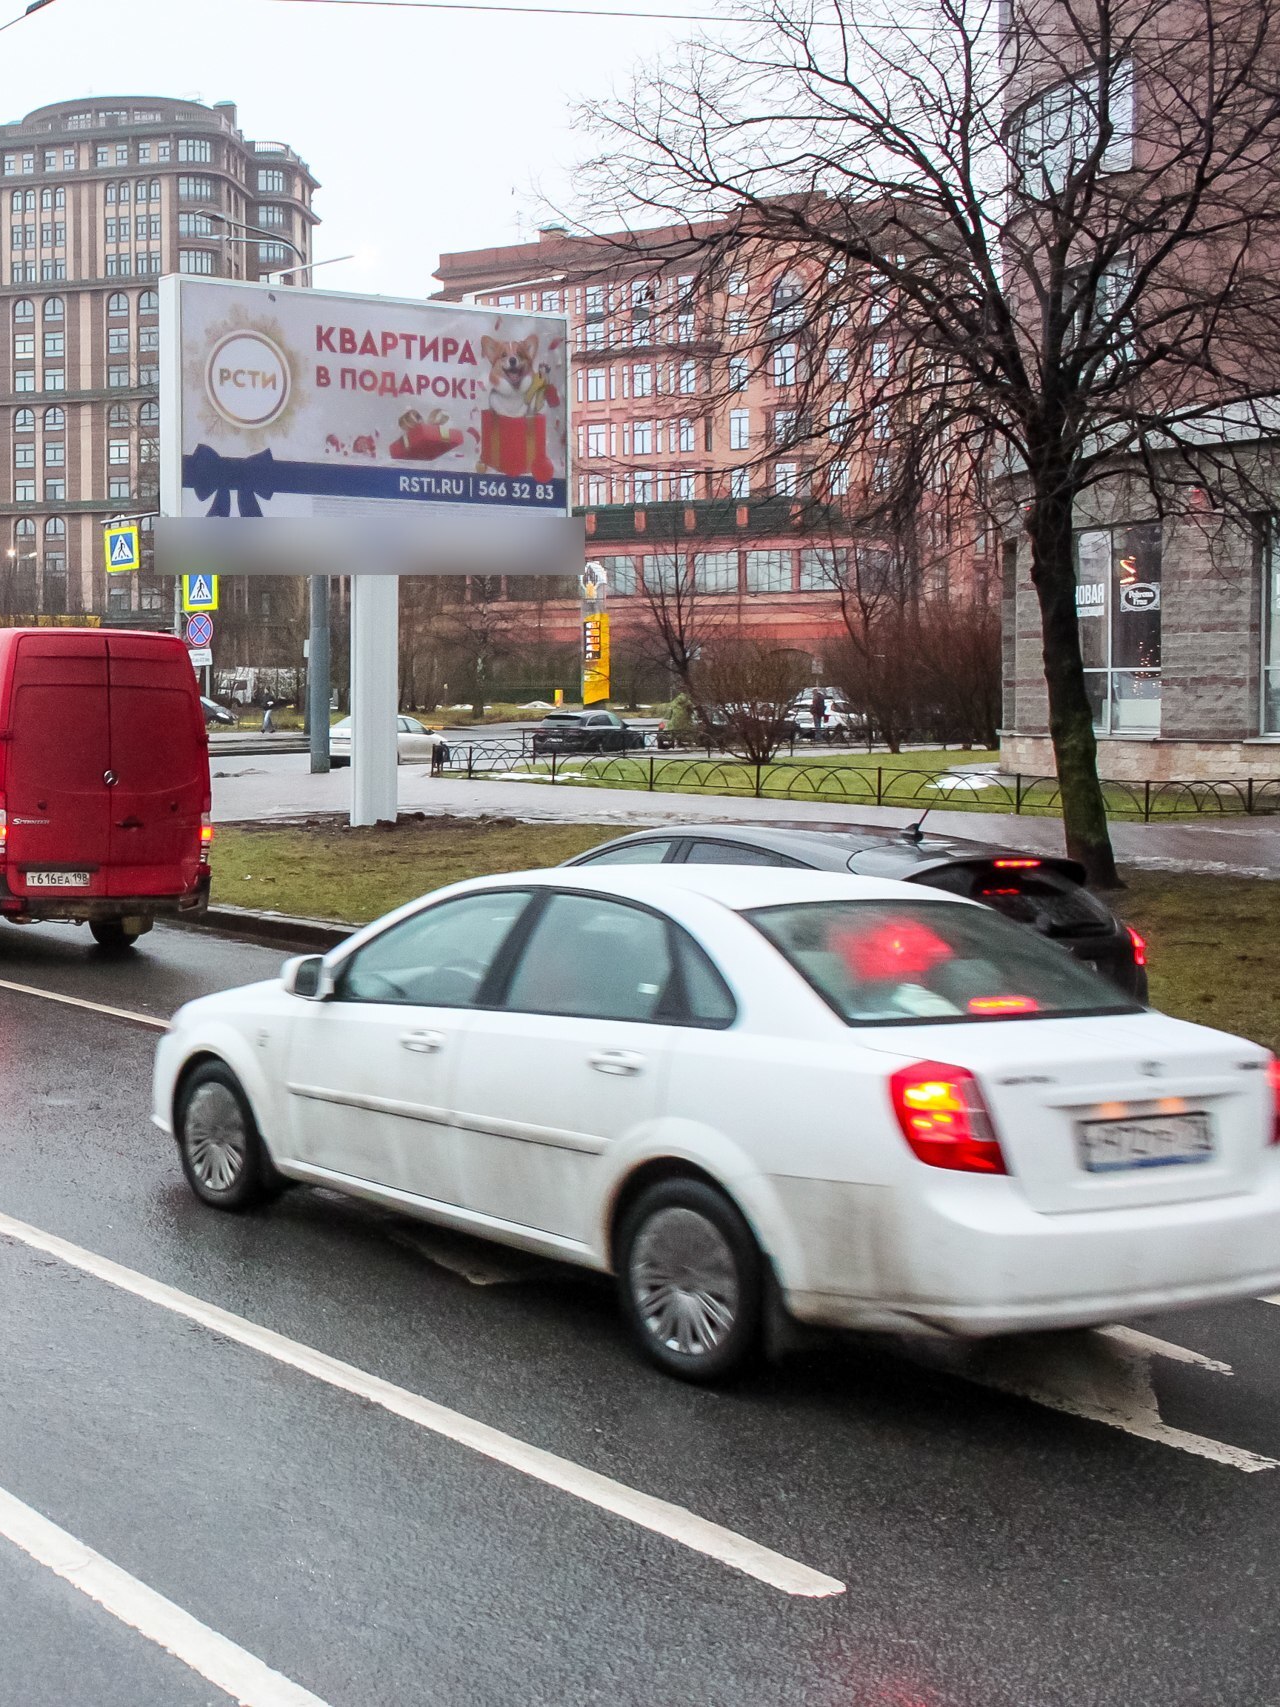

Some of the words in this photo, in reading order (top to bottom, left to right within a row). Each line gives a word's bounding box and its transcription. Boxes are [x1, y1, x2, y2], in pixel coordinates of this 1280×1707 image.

[316, 325, 477, 366] КВАРТИРА
[219, 368, 277, 391] РСТИ
[316, 365, 331, 388] В
[340, 367, 476, 400] ПОДАРОК!
[399, 476, 464, 495] RSTI.RU
[478, 481, 507, 498] 566
[511, 483, 531, 499] 32
[535, 484, 554, 500] 83
